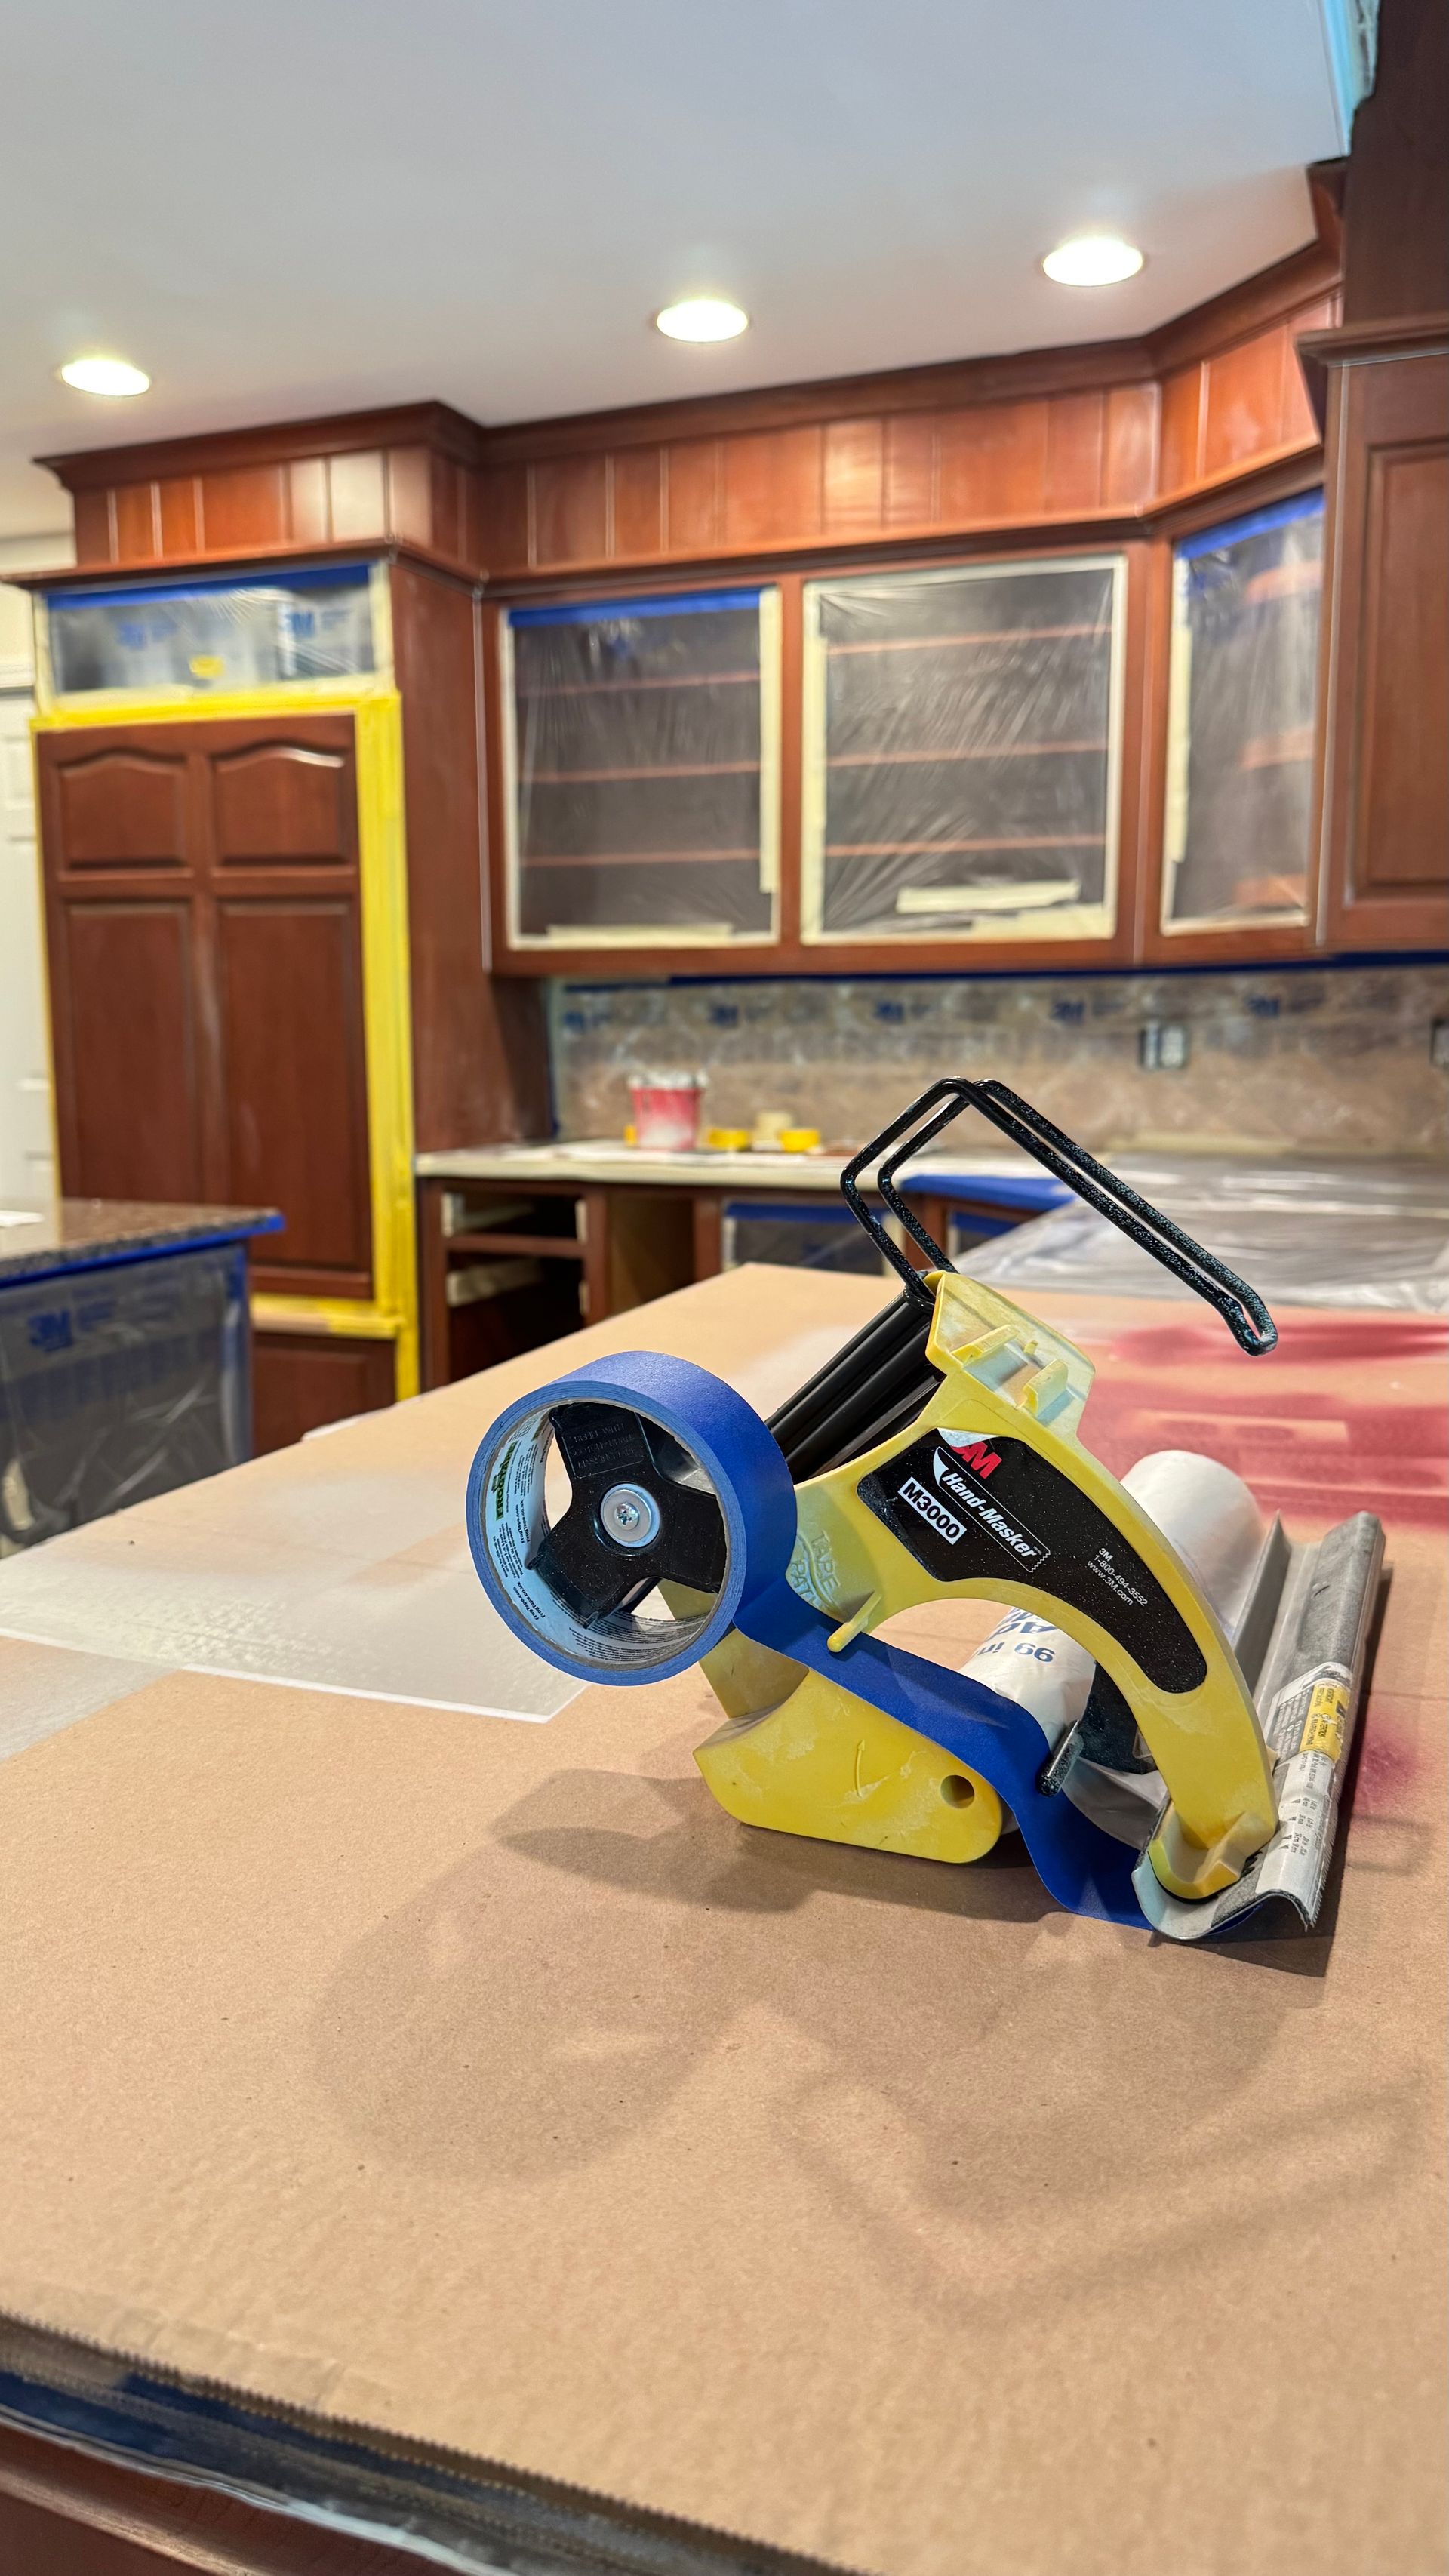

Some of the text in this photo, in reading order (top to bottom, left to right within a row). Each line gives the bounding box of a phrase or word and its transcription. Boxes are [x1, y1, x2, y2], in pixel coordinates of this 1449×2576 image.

[903, 1481, 961, 1538] M3000
[941, 1473, 1037, 1558] Hand-Masker
[811, 1530, 841, 1599] TAPE
[1094, 1554, 1148, 1606] 1-800-494-3552
[1099, 1548, 1113, 1562] 3M
[1087, 1561, 1134, 1605] www.3M.com
[1014, 1642, 1056, 1663] 99
